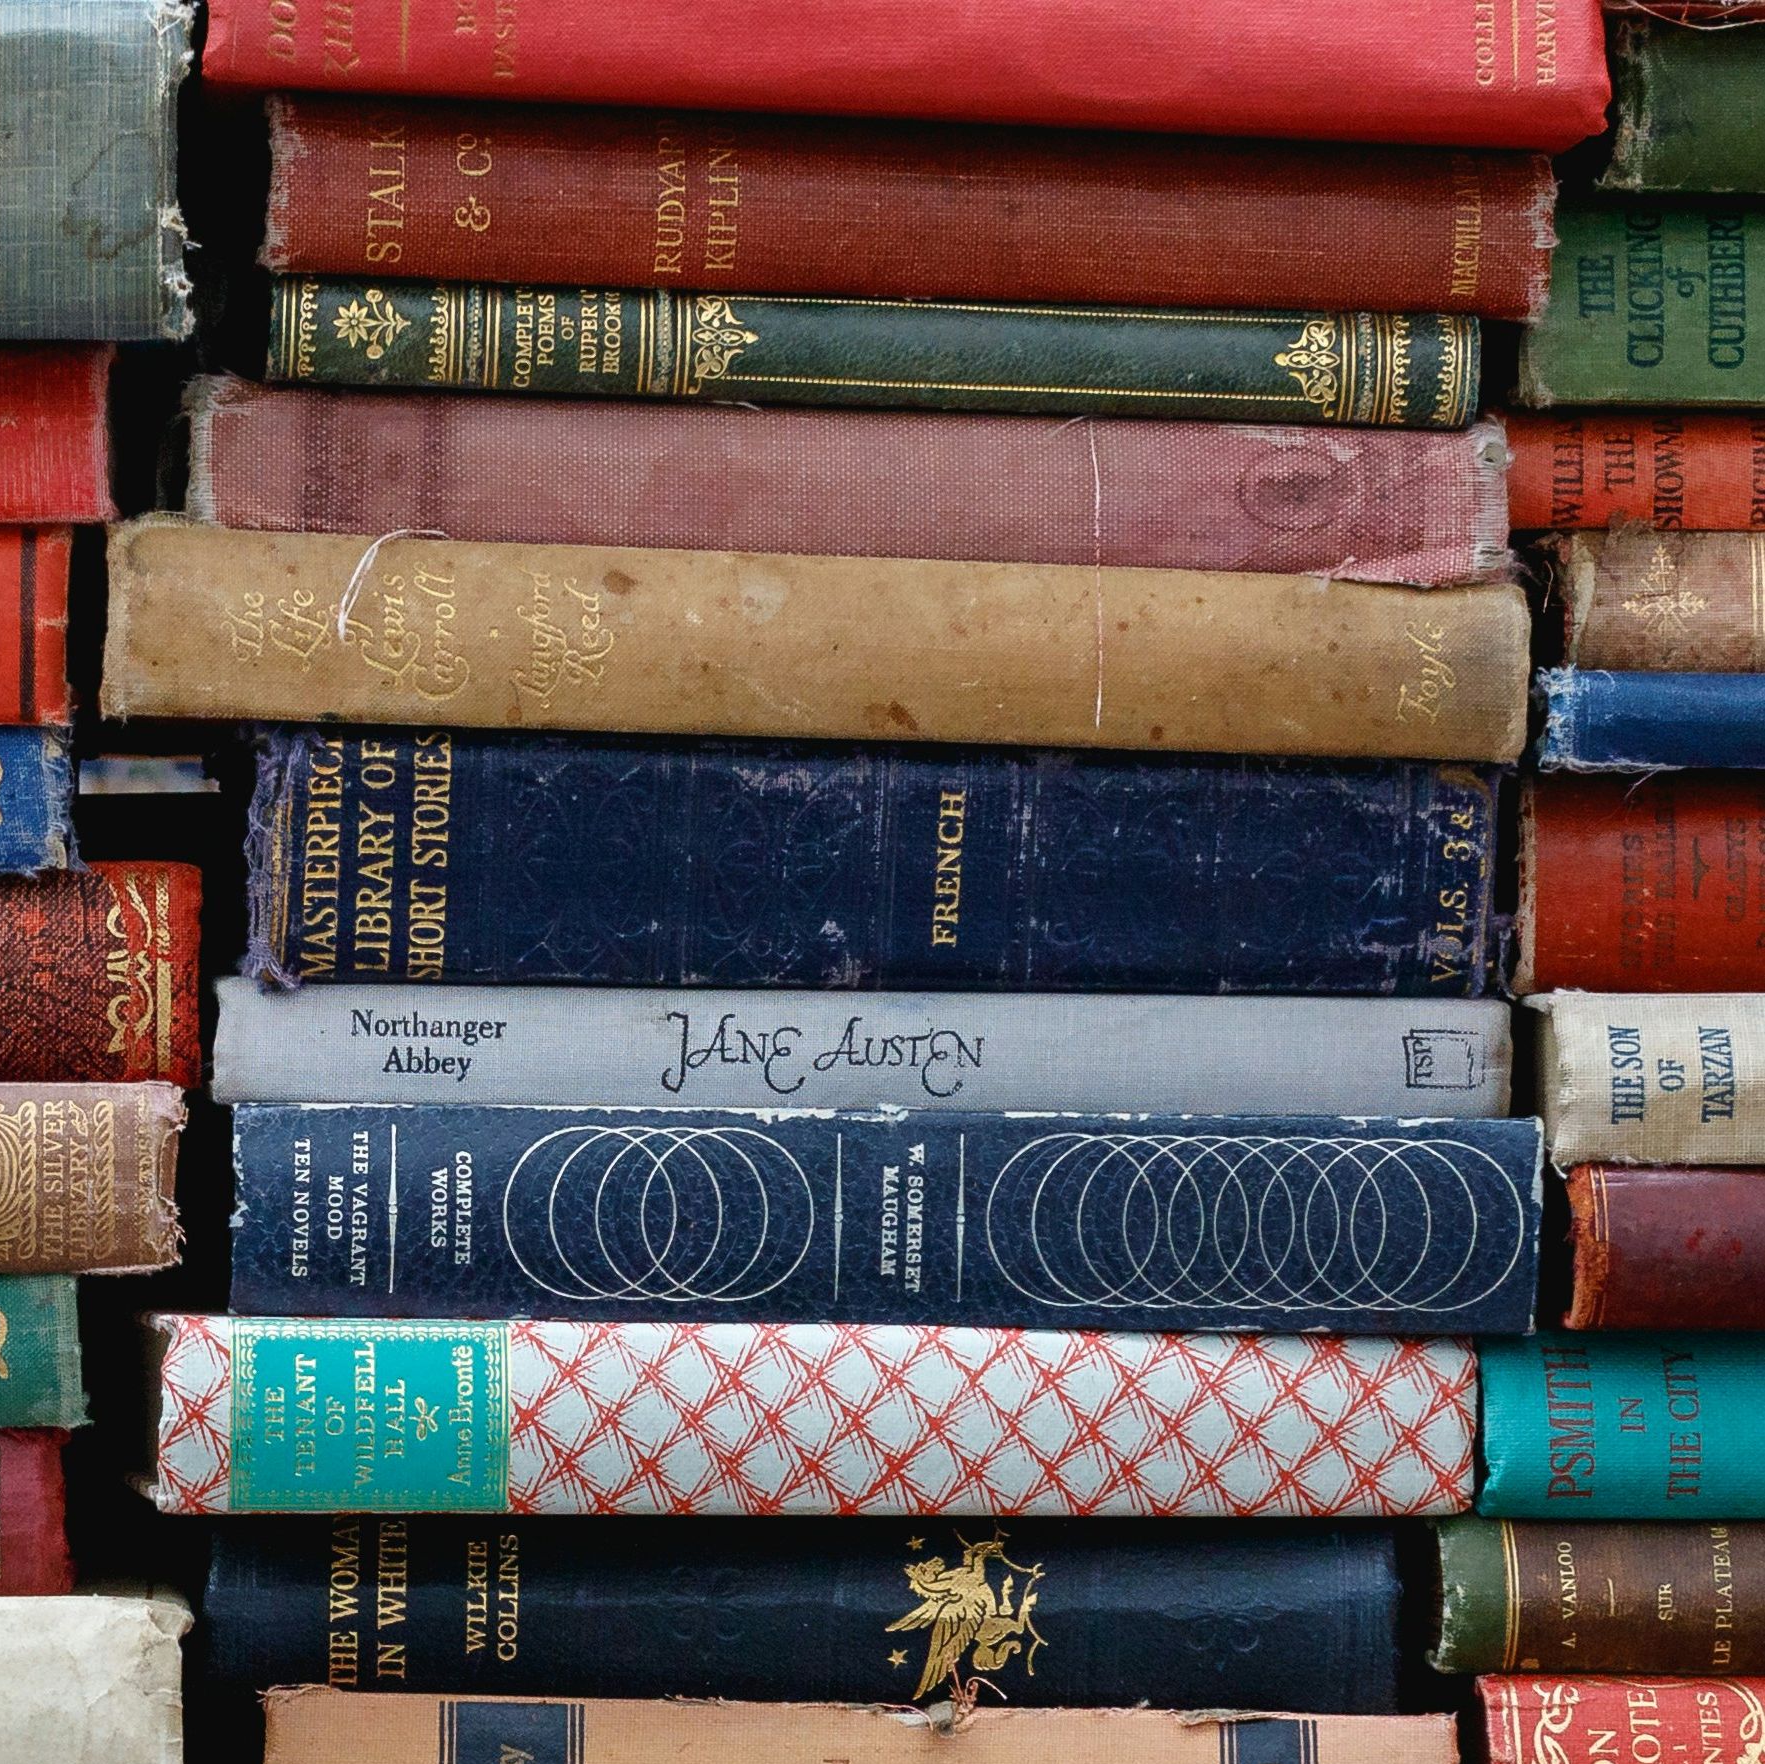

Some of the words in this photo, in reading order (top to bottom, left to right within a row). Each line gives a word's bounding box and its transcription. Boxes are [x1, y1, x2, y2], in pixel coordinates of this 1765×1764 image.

[366, 122, 406, 264] STALK
[455, 197, 491, 232] &
[536, 294, 555, 365] POEMS
[359, 740, 397, 789] OF
[411, 733, 452, 867] STORIES
[355, 801, 397, 973] LIBRARY
[931, 792, 967, 946] FRENCH
[408, 870, 446, 980] SHORT
[351, 1009, 507, 1040] Northanger
[1608, 1025, 1641, 1067] SON
[382, 1047, 473, 1080] Abbey
[1611, 1068, 1644, 1125] THE
[1658, 1057, 1684, 1091] OF
[1698, 1026, 1734, 1123] TARZAN
[294, 1138, 310, 1184] TEN
[352, 1130, 368, 1175] THE
[908, 1144, 925, 1166] W.
[291, 1191, 309, 1277] NOVELS
[327, 1176, 344, 1239] MOOD
[350, 1183, 367, 1285] VAGRANT
[430, 1168, 448, 1248] WORKS
[455, 1151, 472, 1265] COMPLETE
[881, 1166, 899, 1276] MAUGHAM
[905, 1176, 923, 1292] SOMERSET
[264, 1386, 285, 1441] THE
[294, 1355, 317, 1475] TENANT
[325, 1396, 345, 1436] OF
[355, 1341, 376, 1487] WILDFELL
[384, 1379, 406, 1457] HALL
[1543, 1346, 1595, 1499] PSMITH
[1618, 1397, 1645, 1433] IN
[1662, 1350, 1700, 1423] CITY
[448, 1420, 471, 1485] Anne
[1668, 1430, 1703, 1499] THE
[377, 1520, 407, 1627] WHITE
[465, 1542, 488, 1653] WILKIE
[497, 1534, 520, 1661] COLLINS
[1559, 1541, 1577, 1619] VANLOO
[1658, 1583, 1675, 1620] SUR
[330, 1636, 359, 1688] THE
[376, 1645, 404, 1679] IN
